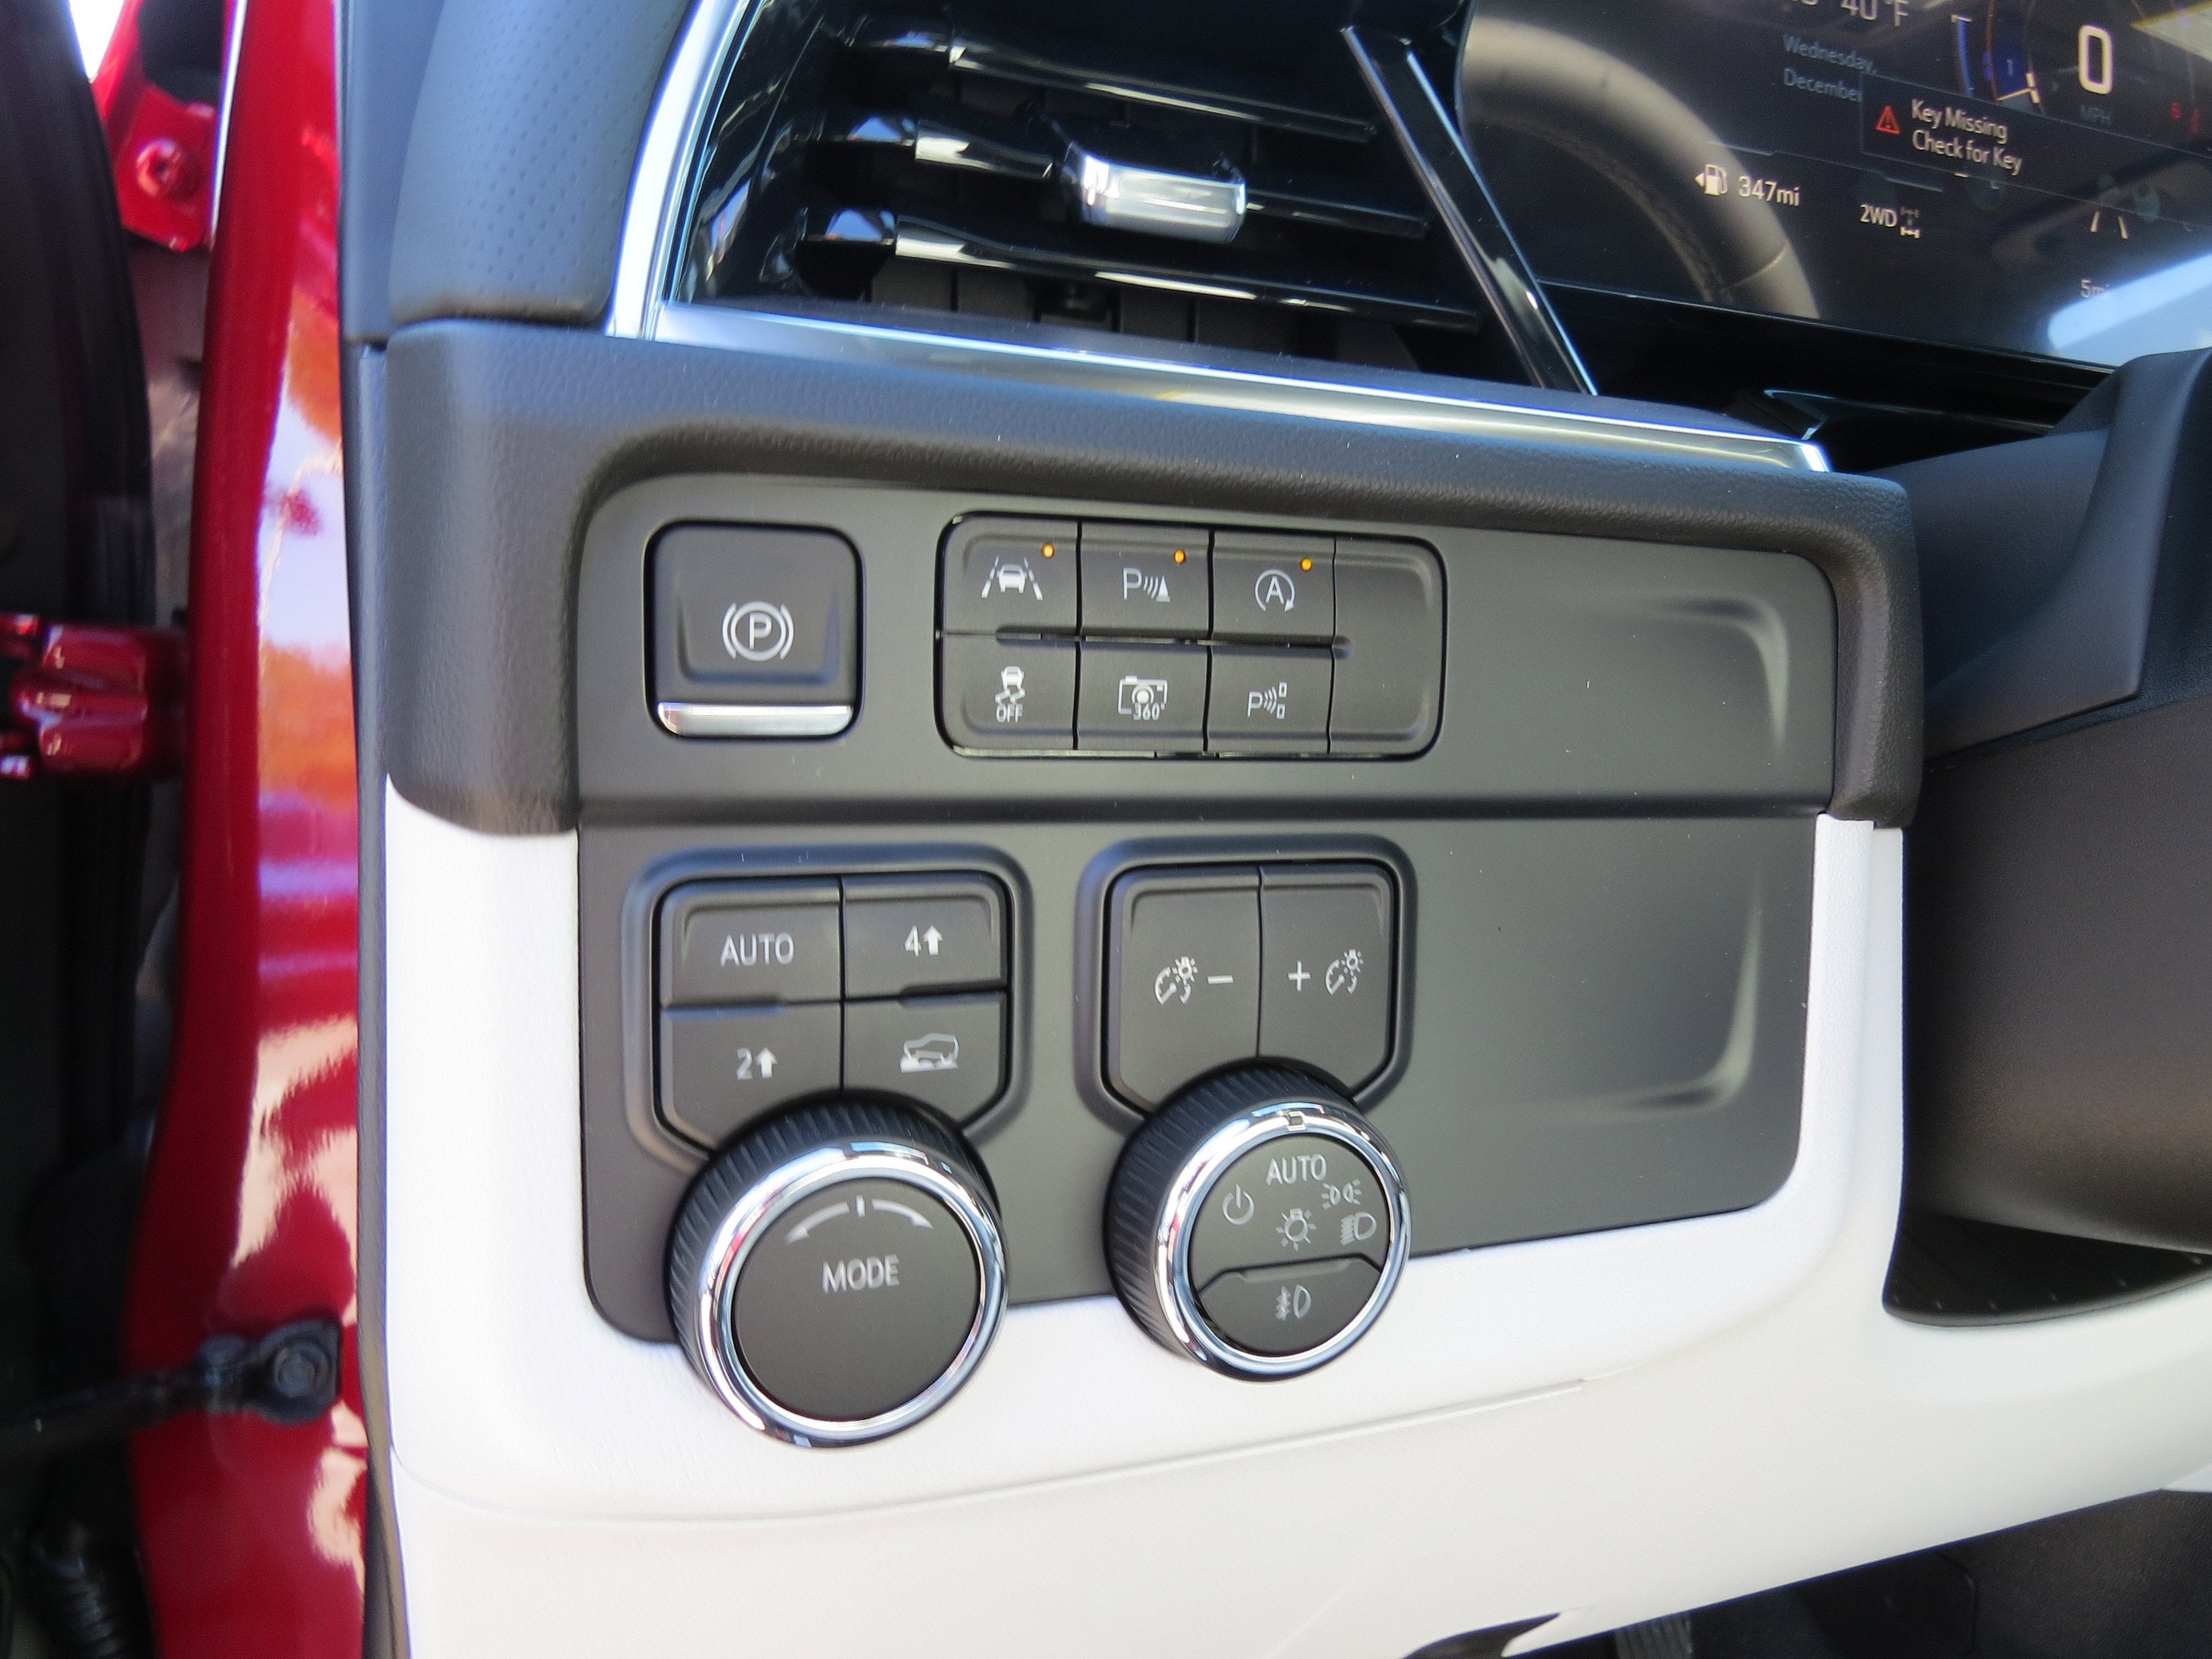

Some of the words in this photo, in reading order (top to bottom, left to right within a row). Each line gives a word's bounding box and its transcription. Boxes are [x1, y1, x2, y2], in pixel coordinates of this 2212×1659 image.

[2078, 24, 2114, 95] 0
[1911, 99, 1943, 129] Key
[1945, 107, 2008, 144] Missing
[1912, 129, 1964, 159] Check
[1965, 139, 1990, 164] for
[1992, 146, 2023, 176] Key
[1860, 204, 1897, 228] 2WD
[749, 612, 772, 650] P
[995, 703, 1023, 723] OFF
[721, 932, 795, 966] AUTO
[904, 925, 922, 957] 4
[736, 1048, 753, 1080] 2
[1265, 1153, 1327, 1185] AUTO
[822, 1254, 900, 1293] MODE
